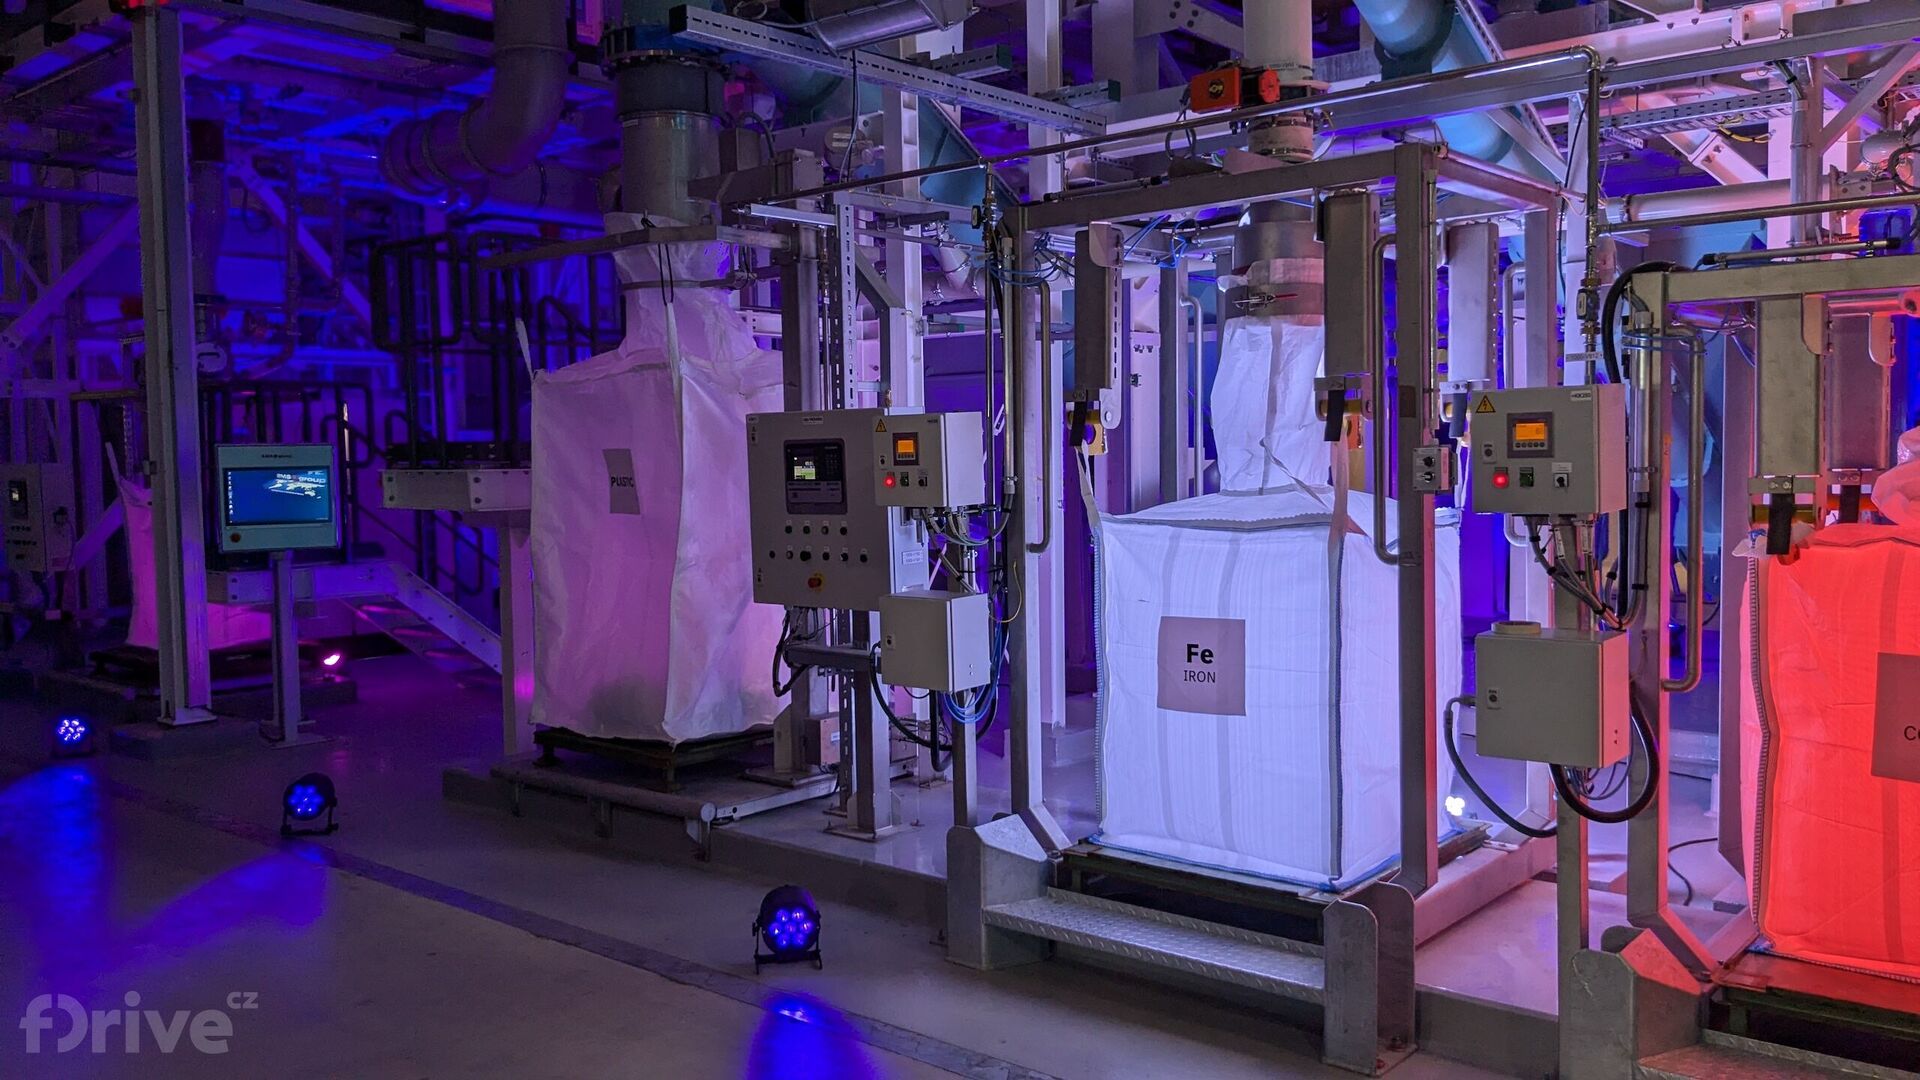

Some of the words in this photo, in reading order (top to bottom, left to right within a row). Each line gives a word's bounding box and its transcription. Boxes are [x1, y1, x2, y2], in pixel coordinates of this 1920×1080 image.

[298, 476, 326, 484] group
[1186, 643, 1214, 664] Fe
[1183, 669, 1216, 684] IRON
